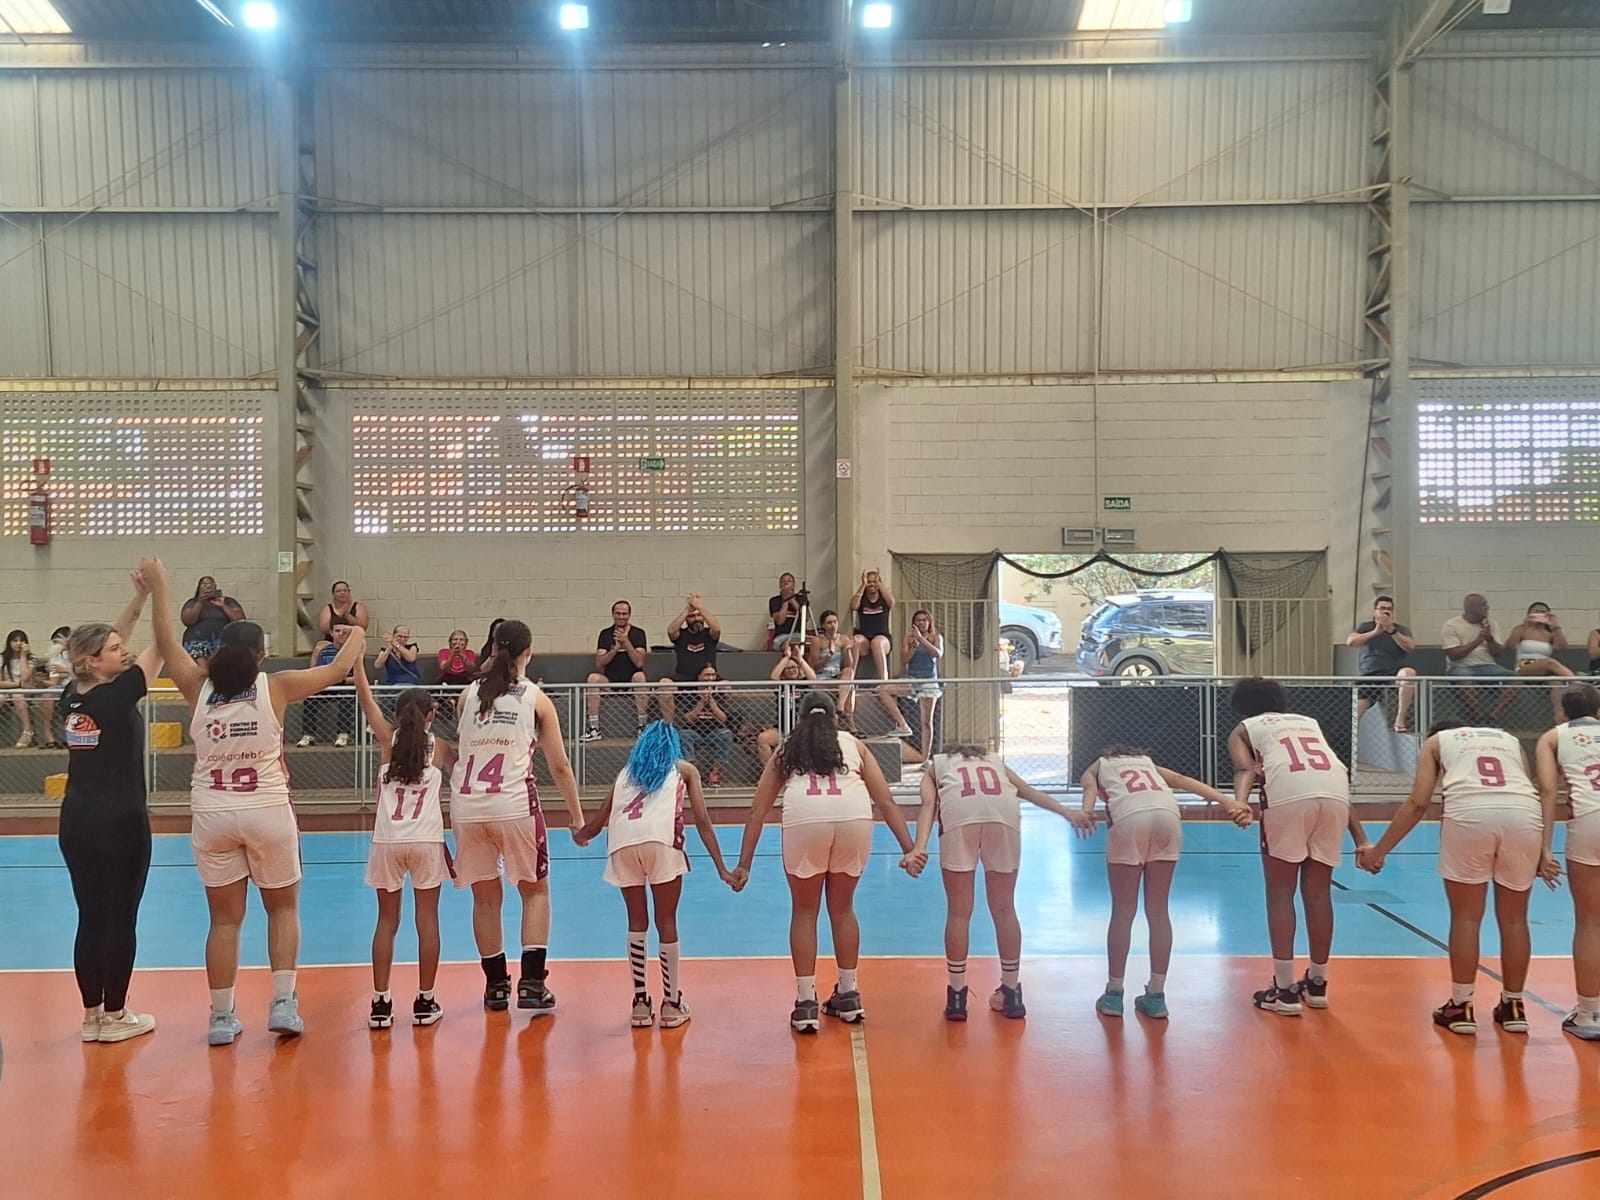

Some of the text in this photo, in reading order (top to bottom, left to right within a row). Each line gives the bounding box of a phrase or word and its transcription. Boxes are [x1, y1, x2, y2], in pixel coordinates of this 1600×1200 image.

[1279, 736, 1331, 772] 15
[459, 753, 505, 794] 14
[806, 768, 842, 796] 11
[957, 766, 1002, 798] 10
[1120, 769, 1163, 794] 21
[1476, 756, 1507, 787] 9
[391, 787, 428, 821] 17
[622, 791, 648, 820] 4
